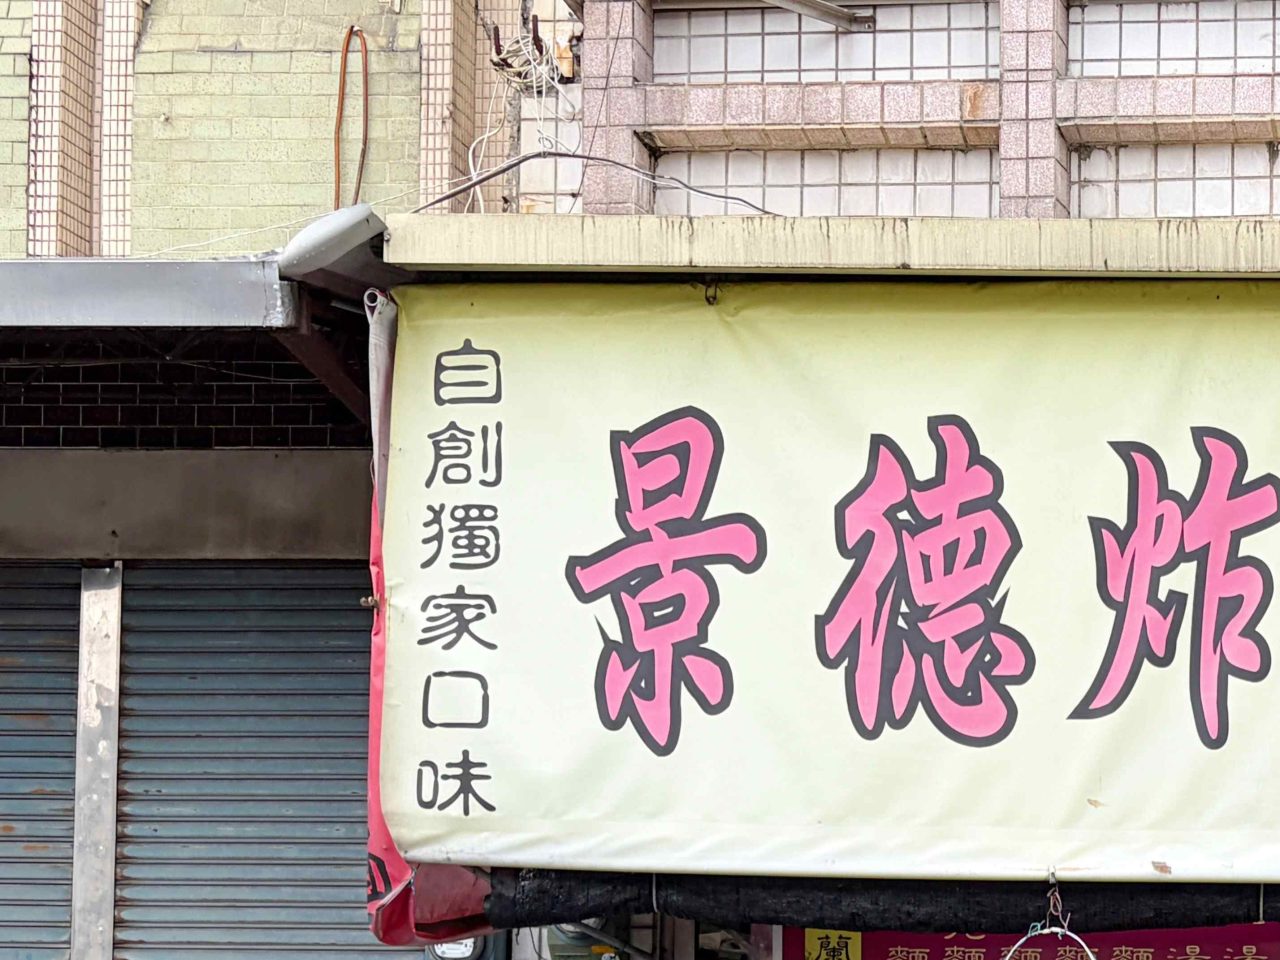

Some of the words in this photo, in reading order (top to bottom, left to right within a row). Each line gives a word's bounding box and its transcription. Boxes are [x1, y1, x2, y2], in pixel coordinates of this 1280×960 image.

[416, 339, 503, 817] 自創獨家口味
